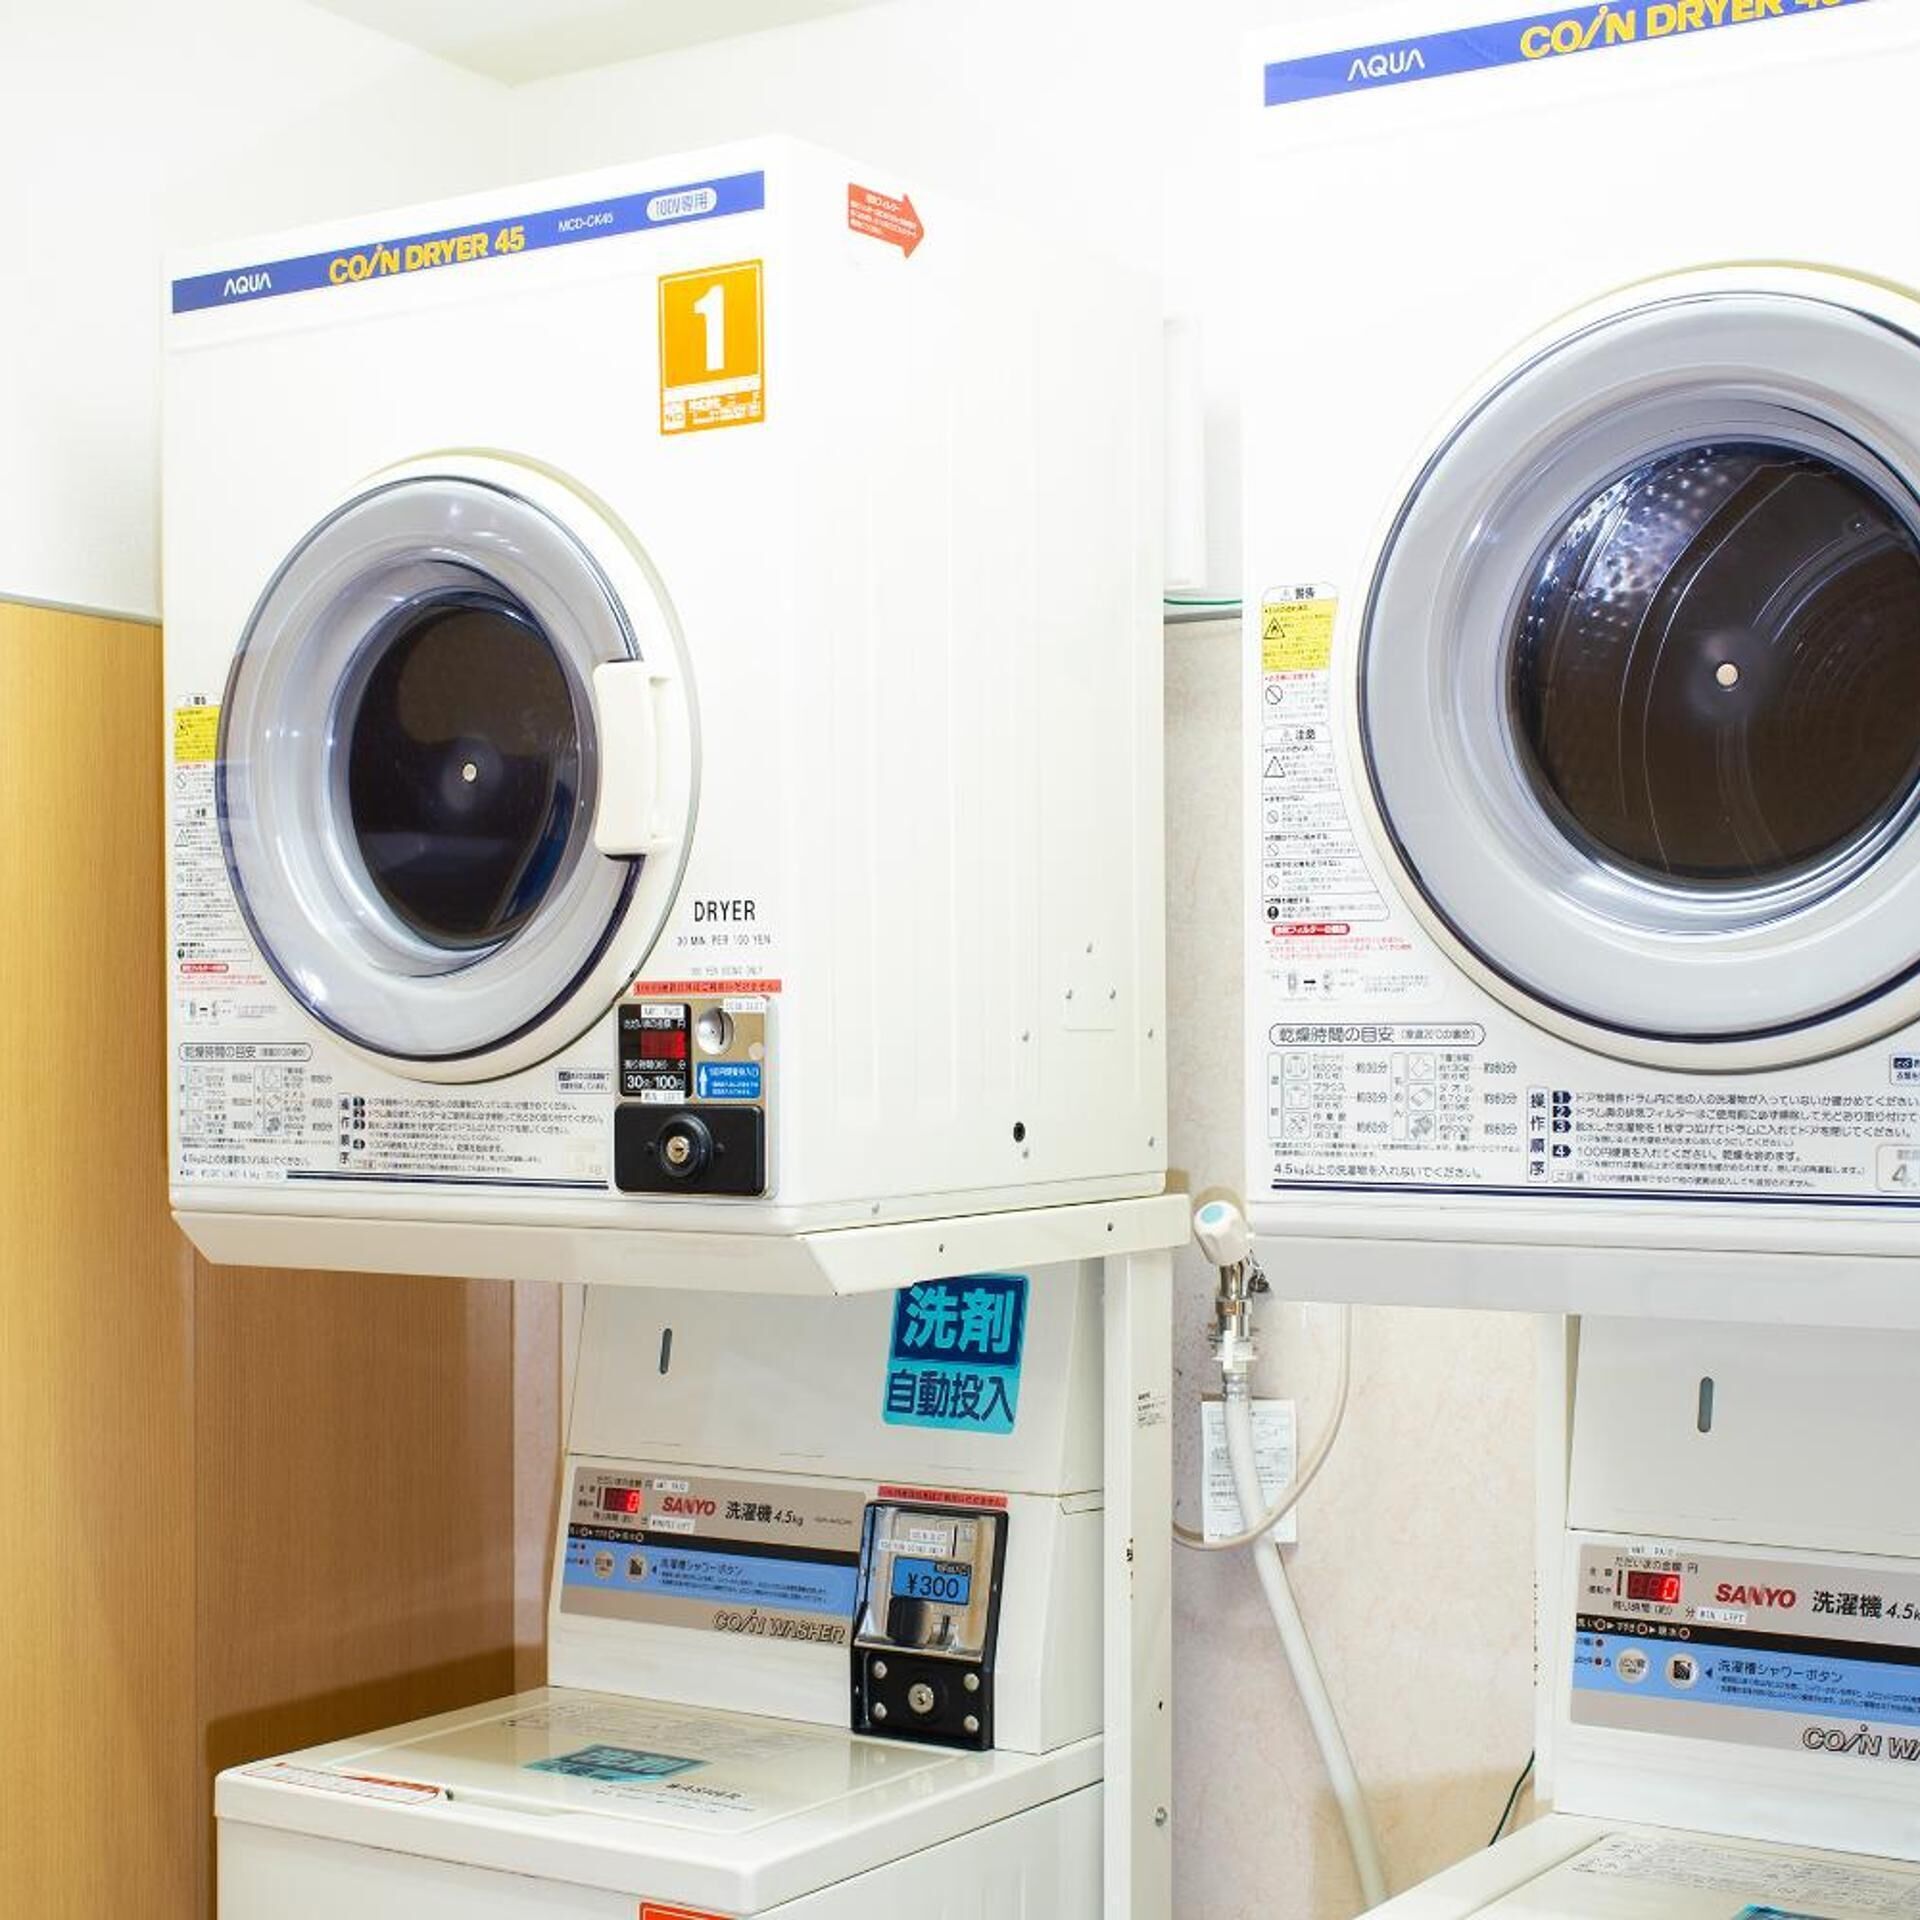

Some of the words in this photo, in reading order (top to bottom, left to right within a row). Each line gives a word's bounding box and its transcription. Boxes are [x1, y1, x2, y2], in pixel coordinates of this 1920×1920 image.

[1520, 6, 1635, 60] COIN
[1348, 48, 1424, 81] AQUA
[330, 242, 400, 286] COIN
[404, 232, 489, 273] DRYER
[494, 226, 526, 255] 45
[223, 272, 272, 297] AQUA
[693, 284, 725, 372] 1
[694, 900, 756, 922] DRYER
[711, 935, 729, 945] PER
[753, 934, 771, 945] YEN
[1279, 1026, 1395, 1043] 乾燥時間の目安
[902, 1285, 1016, 1353] 洗剤
[886, 1369, 1015, 1424] 自動投入
[662, 1496, 717, 1517] SANYO
[725, 1500, 773, 1524] 洗濯機
[773, 1510, 805, 1528] 4.5kg
[1687, 1561, 1699, 1575] 円
[906, 1571, 961, 1600] ¥300
[1715, 1583, 1797, 1609] SANYO
[1811, 1590, 1882, 1618] 洗濯機
[768, 1614, 846, 1645] WASHER
[1717, 1658, 1843, 1682] 洗濯槽シャワーボタン
[1802, 1725, 1882, 1757] COIN
